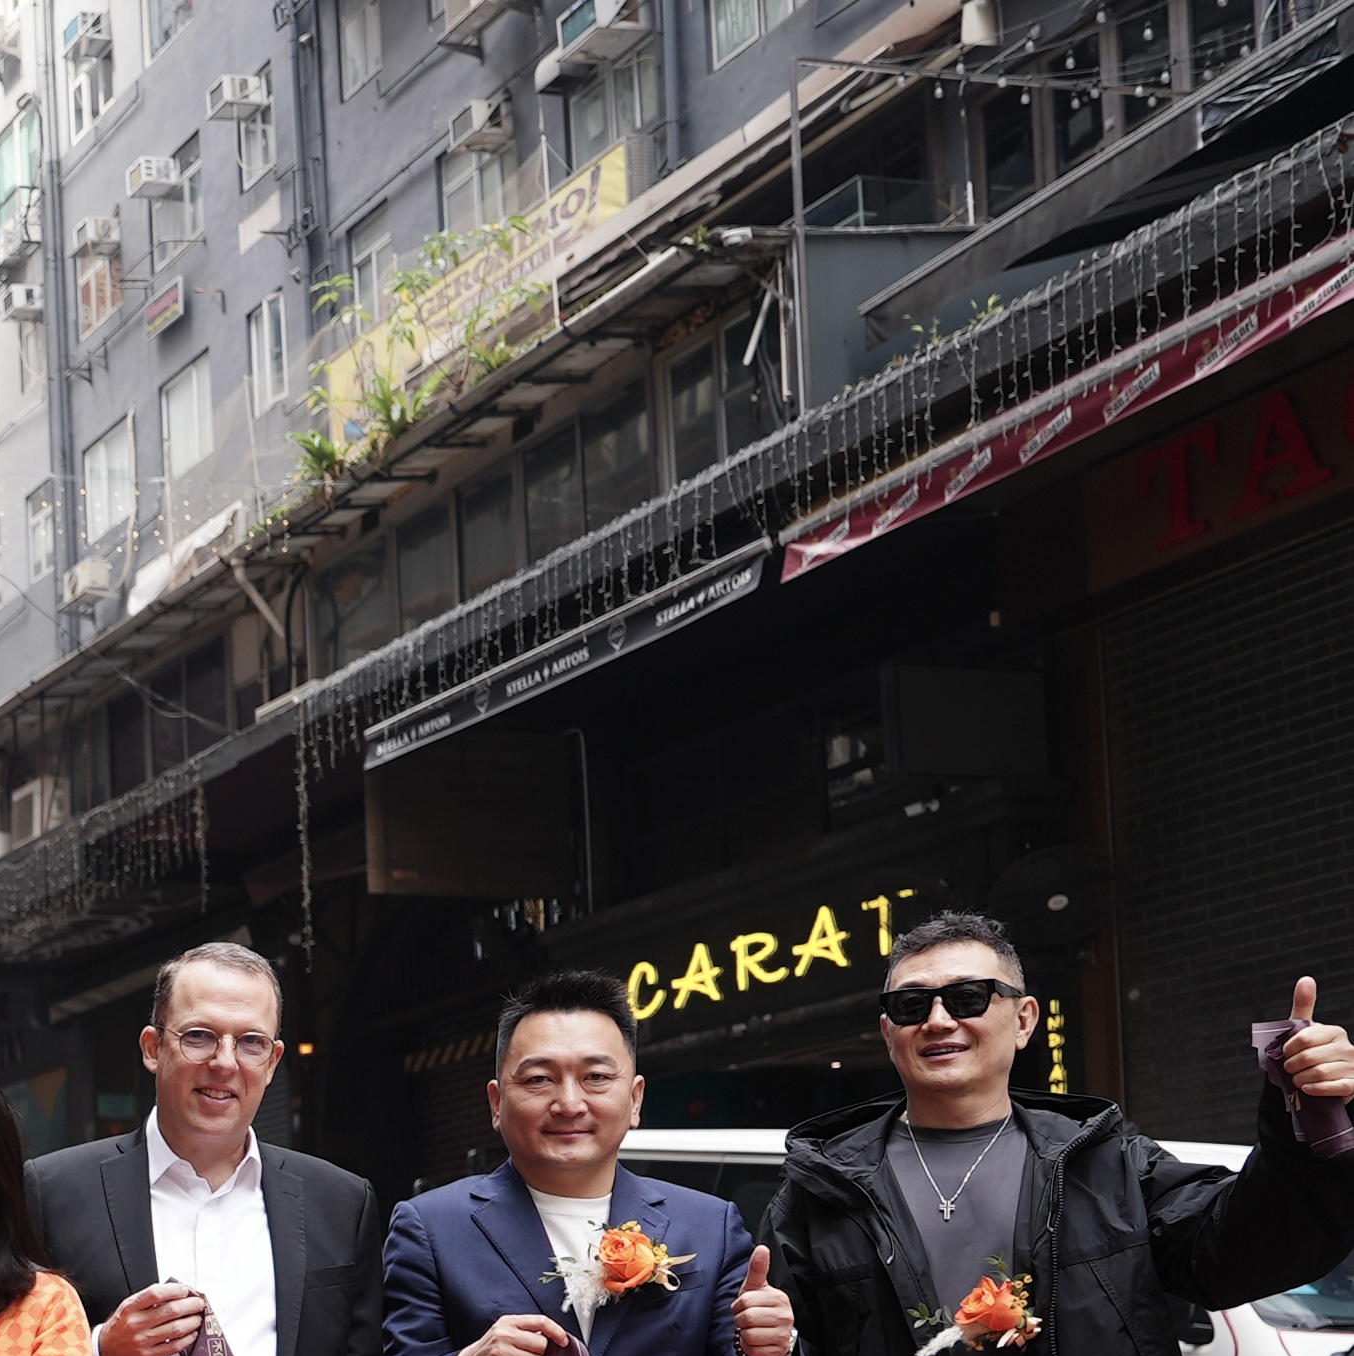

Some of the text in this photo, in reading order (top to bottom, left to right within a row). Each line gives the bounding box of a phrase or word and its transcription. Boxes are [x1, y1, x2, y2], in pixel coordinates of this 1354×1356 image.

[1136, 375, 1354, 551] TA
[655, 566, 753, 628] STELLA ARTOIS
[505, 645, 590, 697] STELLA ARTOIS
